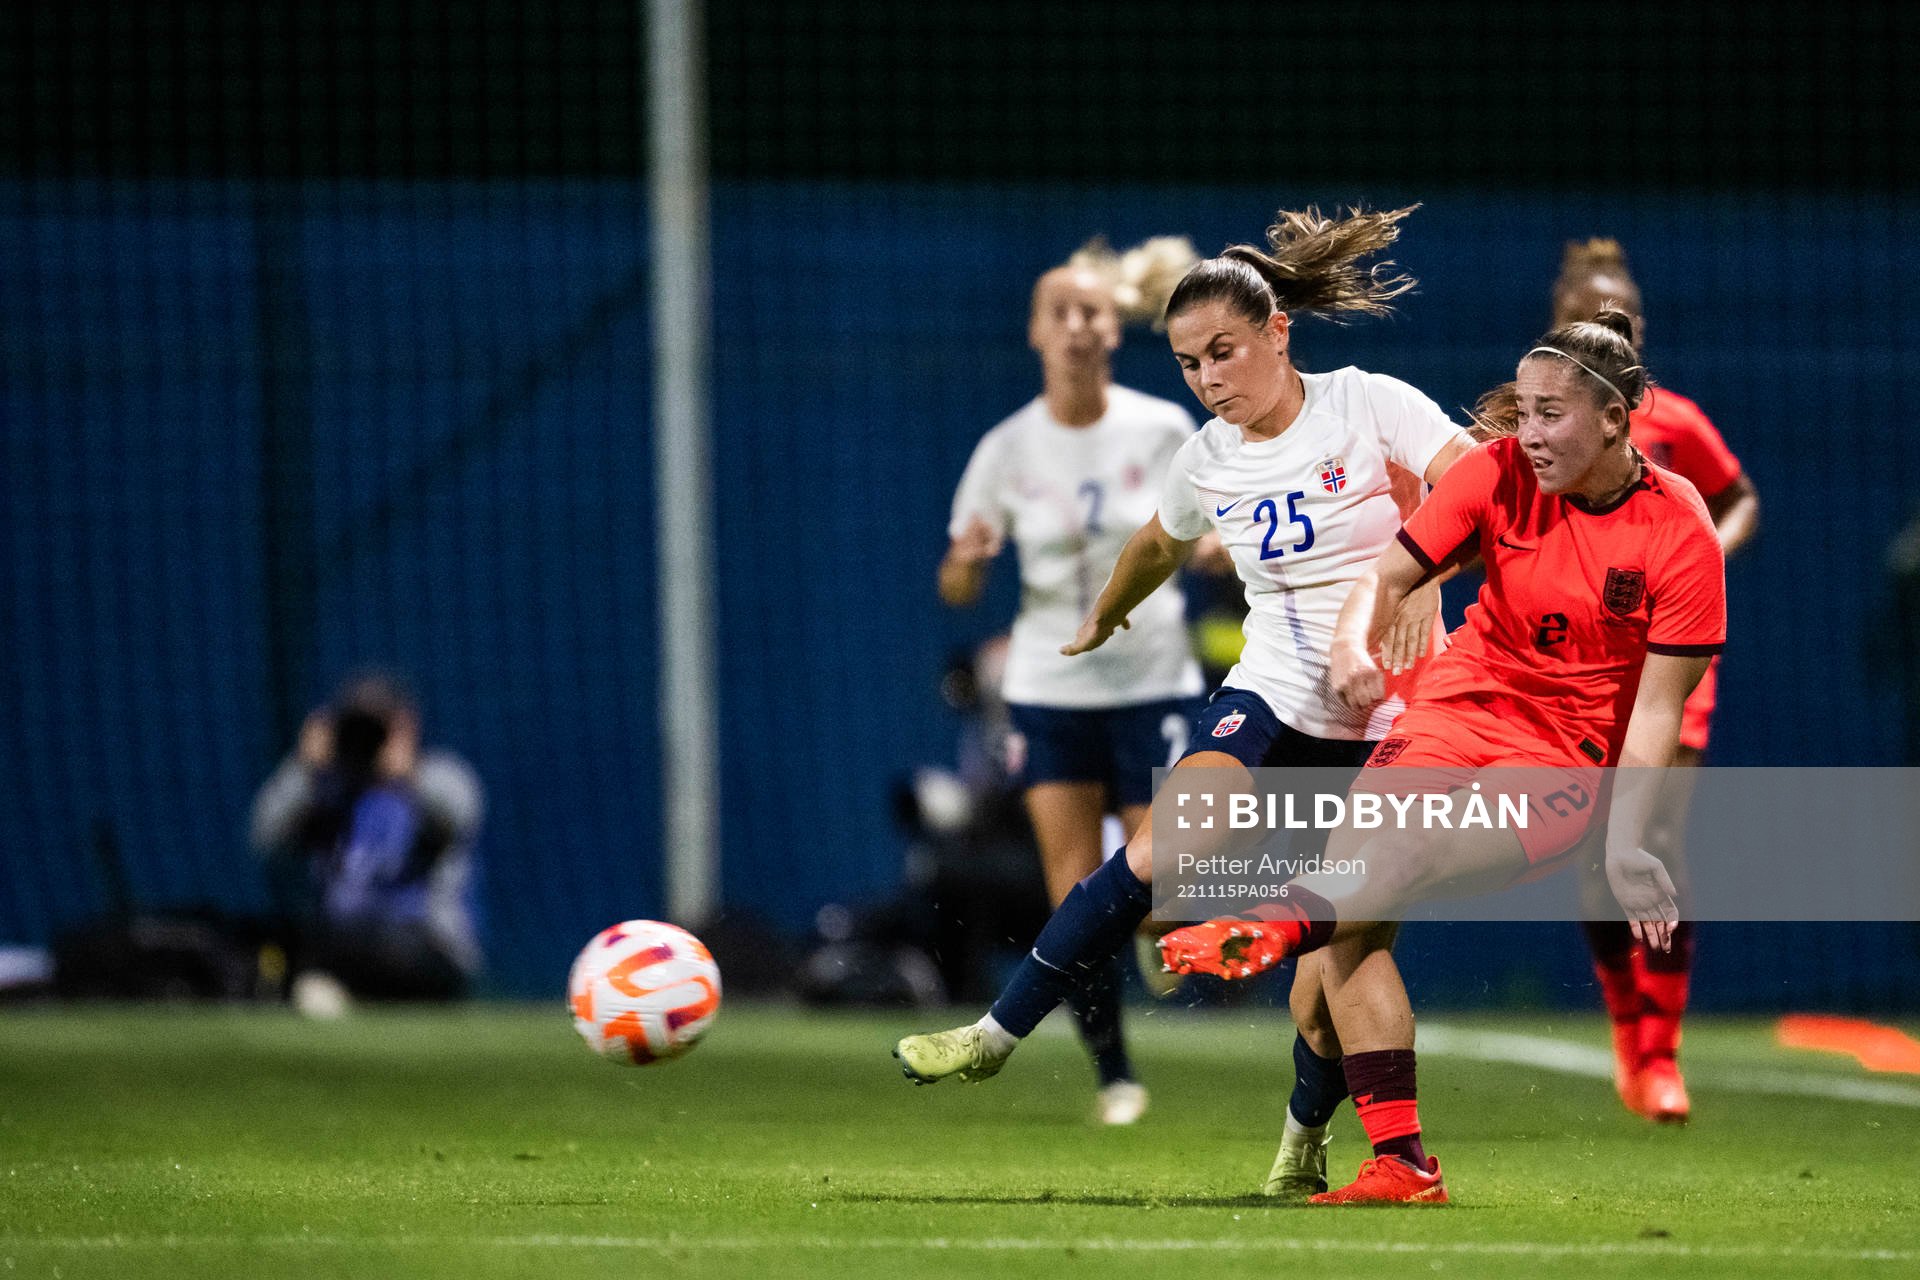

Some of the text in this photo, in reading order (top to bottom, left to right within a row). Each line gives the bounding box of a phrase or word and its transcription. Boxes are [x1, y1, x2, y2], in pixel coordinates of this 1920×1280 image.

[1253, 490, 1315, 561] 25
[1536, 612, 1569, 647] 2
[1543, 783, 1590, 817] 2
